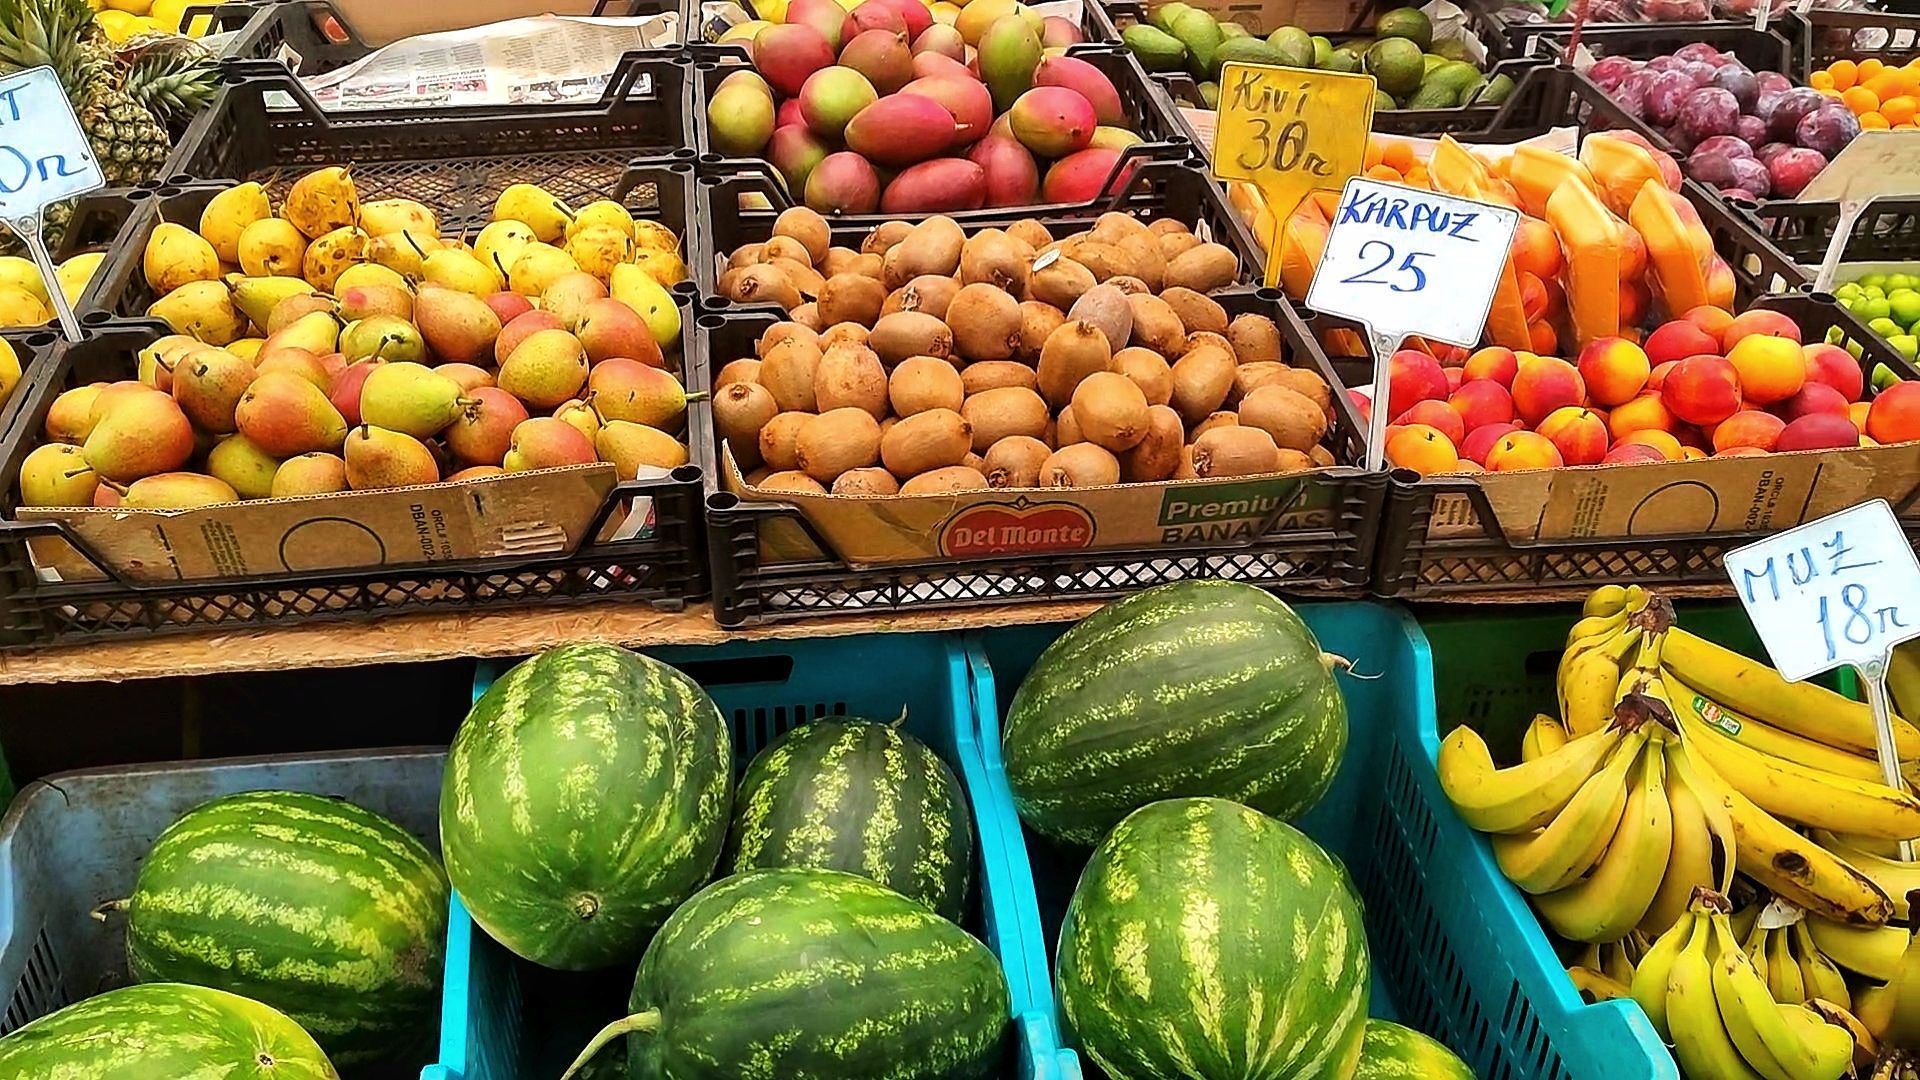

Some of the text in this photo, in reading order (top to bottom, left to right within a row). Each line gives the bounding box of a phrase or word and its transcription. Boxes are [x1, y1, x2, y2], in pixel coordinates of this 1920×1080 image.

[0, 82, 31, 125] T
[1340, 188, 1480, 242] KARPUZ
[1340, 240, 1436, 292] 25
[955, 525, 1085, 547] Del Monte
[1160, 512, 1325, 544] BANAAS
[1744, 531, 1883, 604] MUZ
